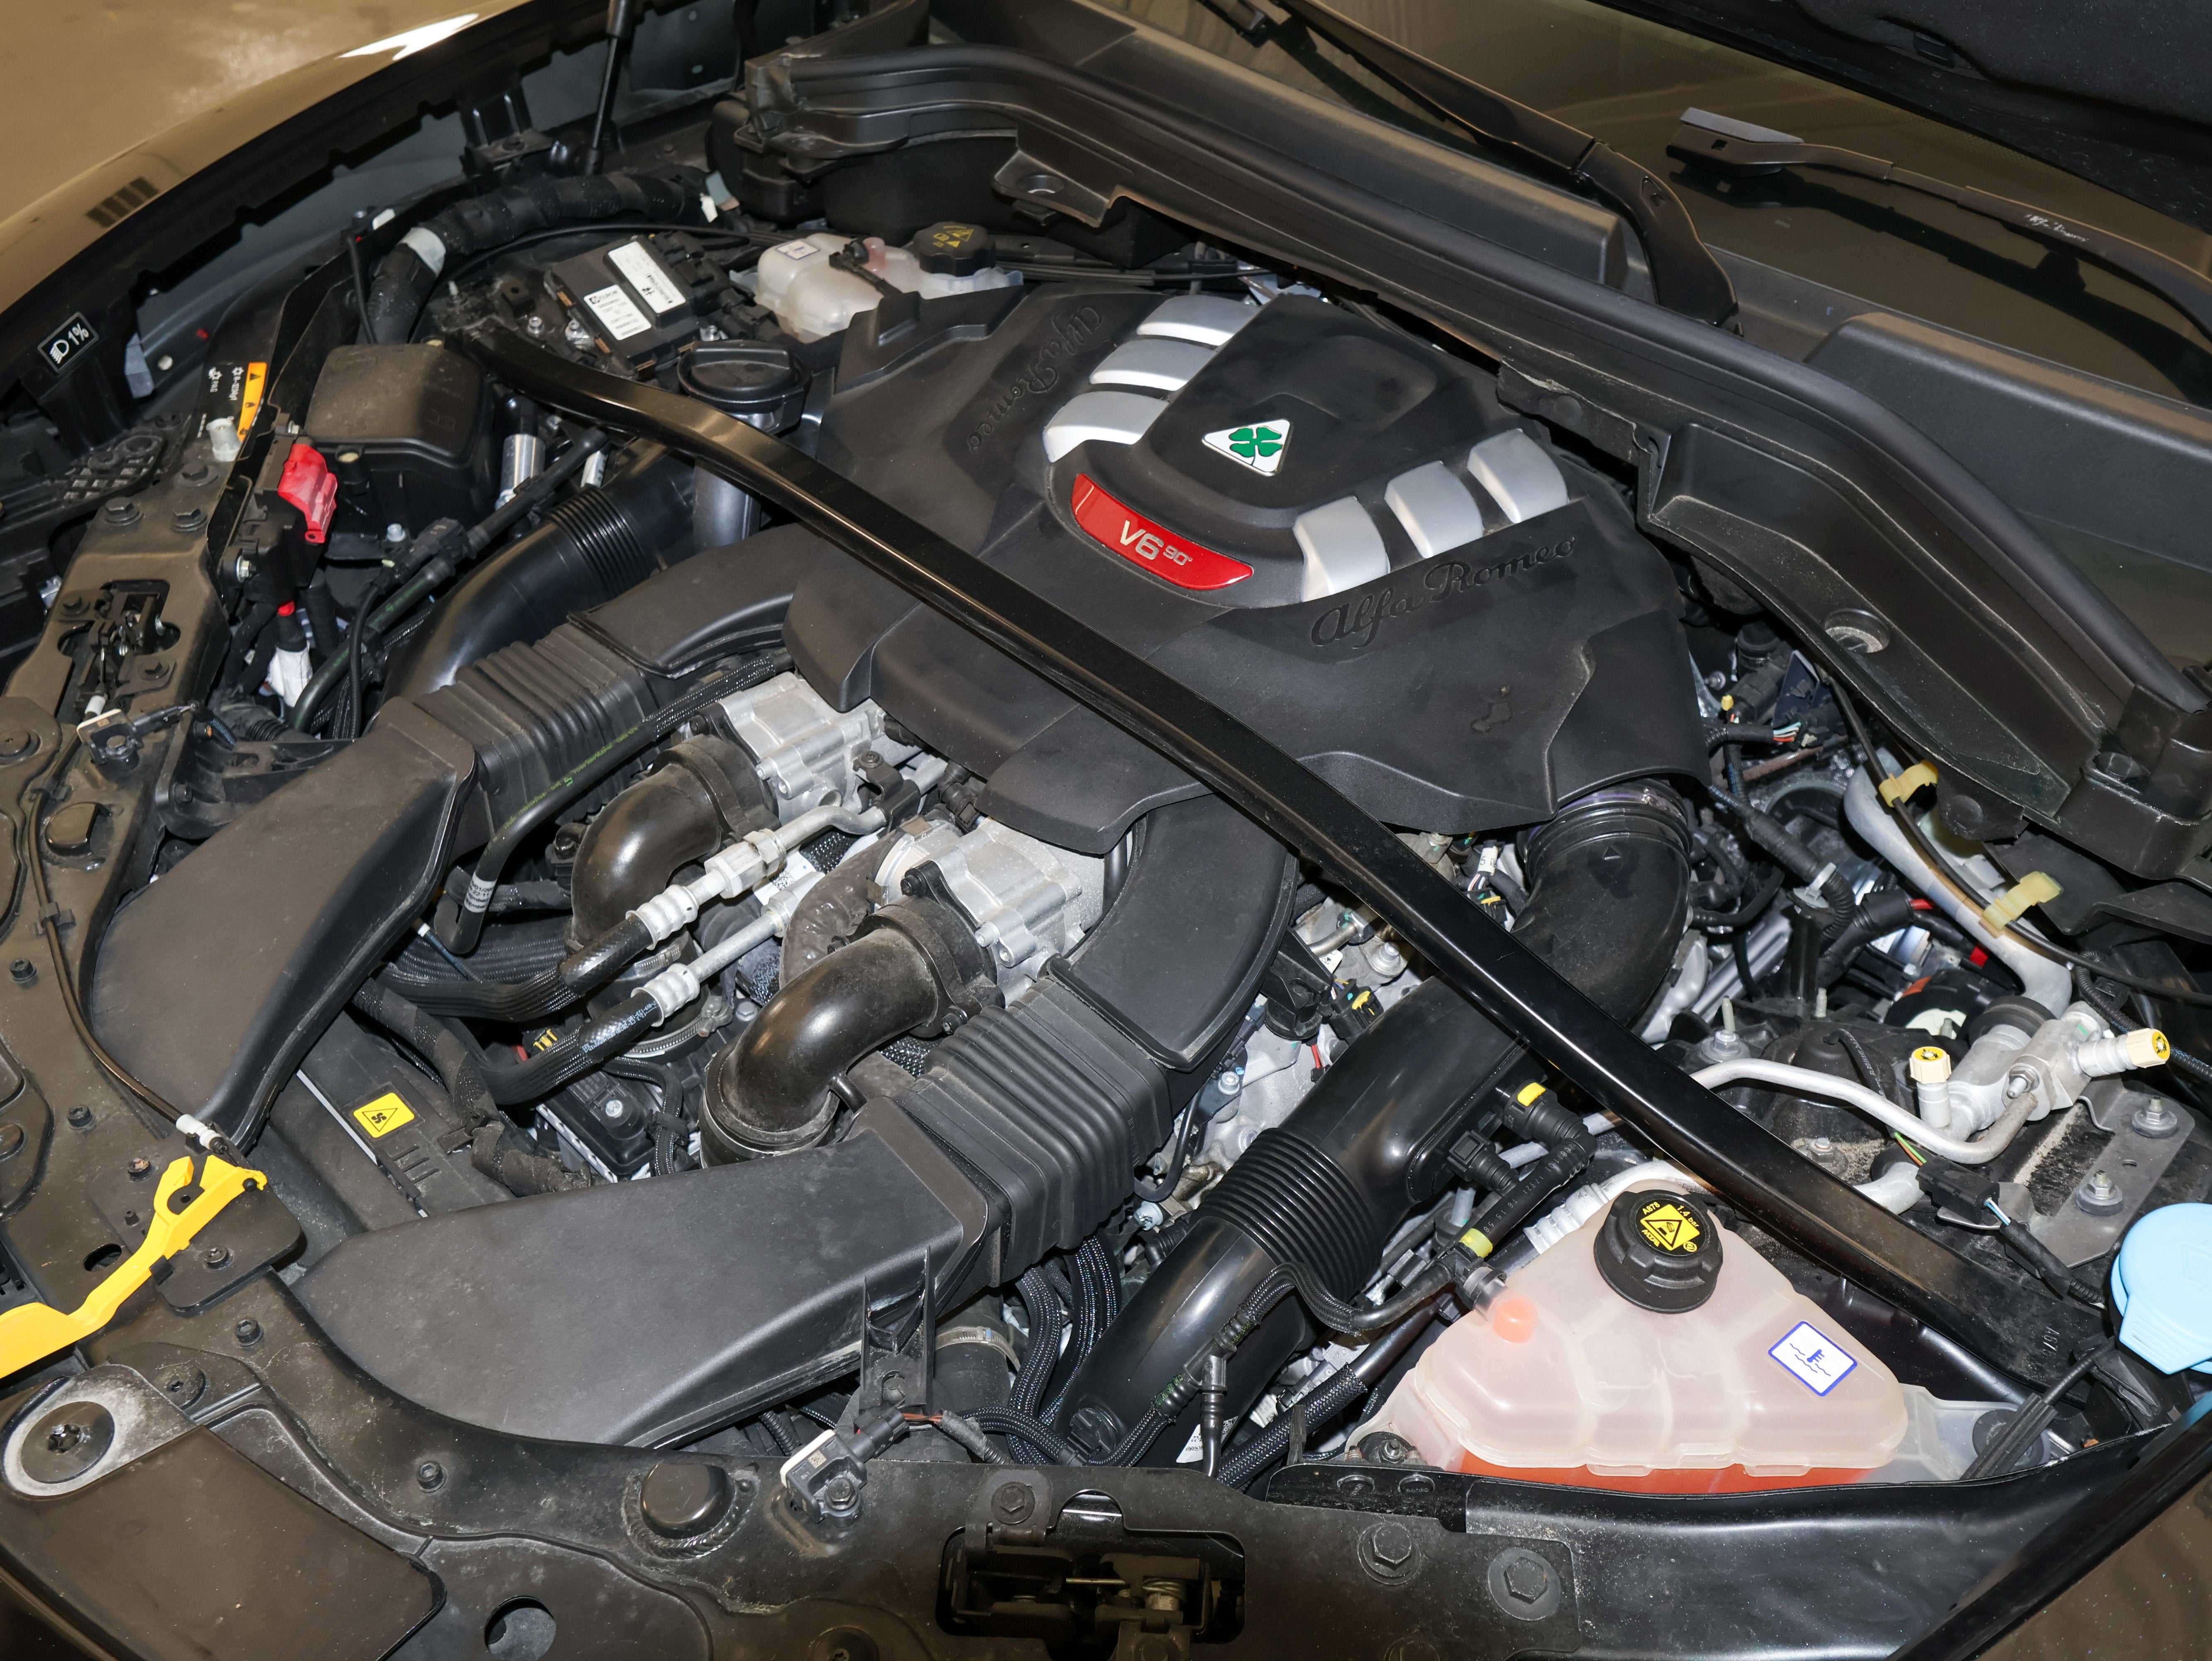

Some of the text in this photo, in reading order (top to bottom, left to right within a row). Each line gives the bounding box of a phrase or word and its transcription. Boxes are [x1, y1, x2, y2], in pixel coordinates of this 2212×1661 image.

[67, 322, 89, 345] 1%
[1120, 520, 1164, 560] V6
[1311, 537, 1575, 649] Alfa Romeo
[1522, 1174, 1544, 1196] 17321
[1642, 1202, 1660, 1215] A878
[1677, 1205, 1700, 1227] 1.4 bar
